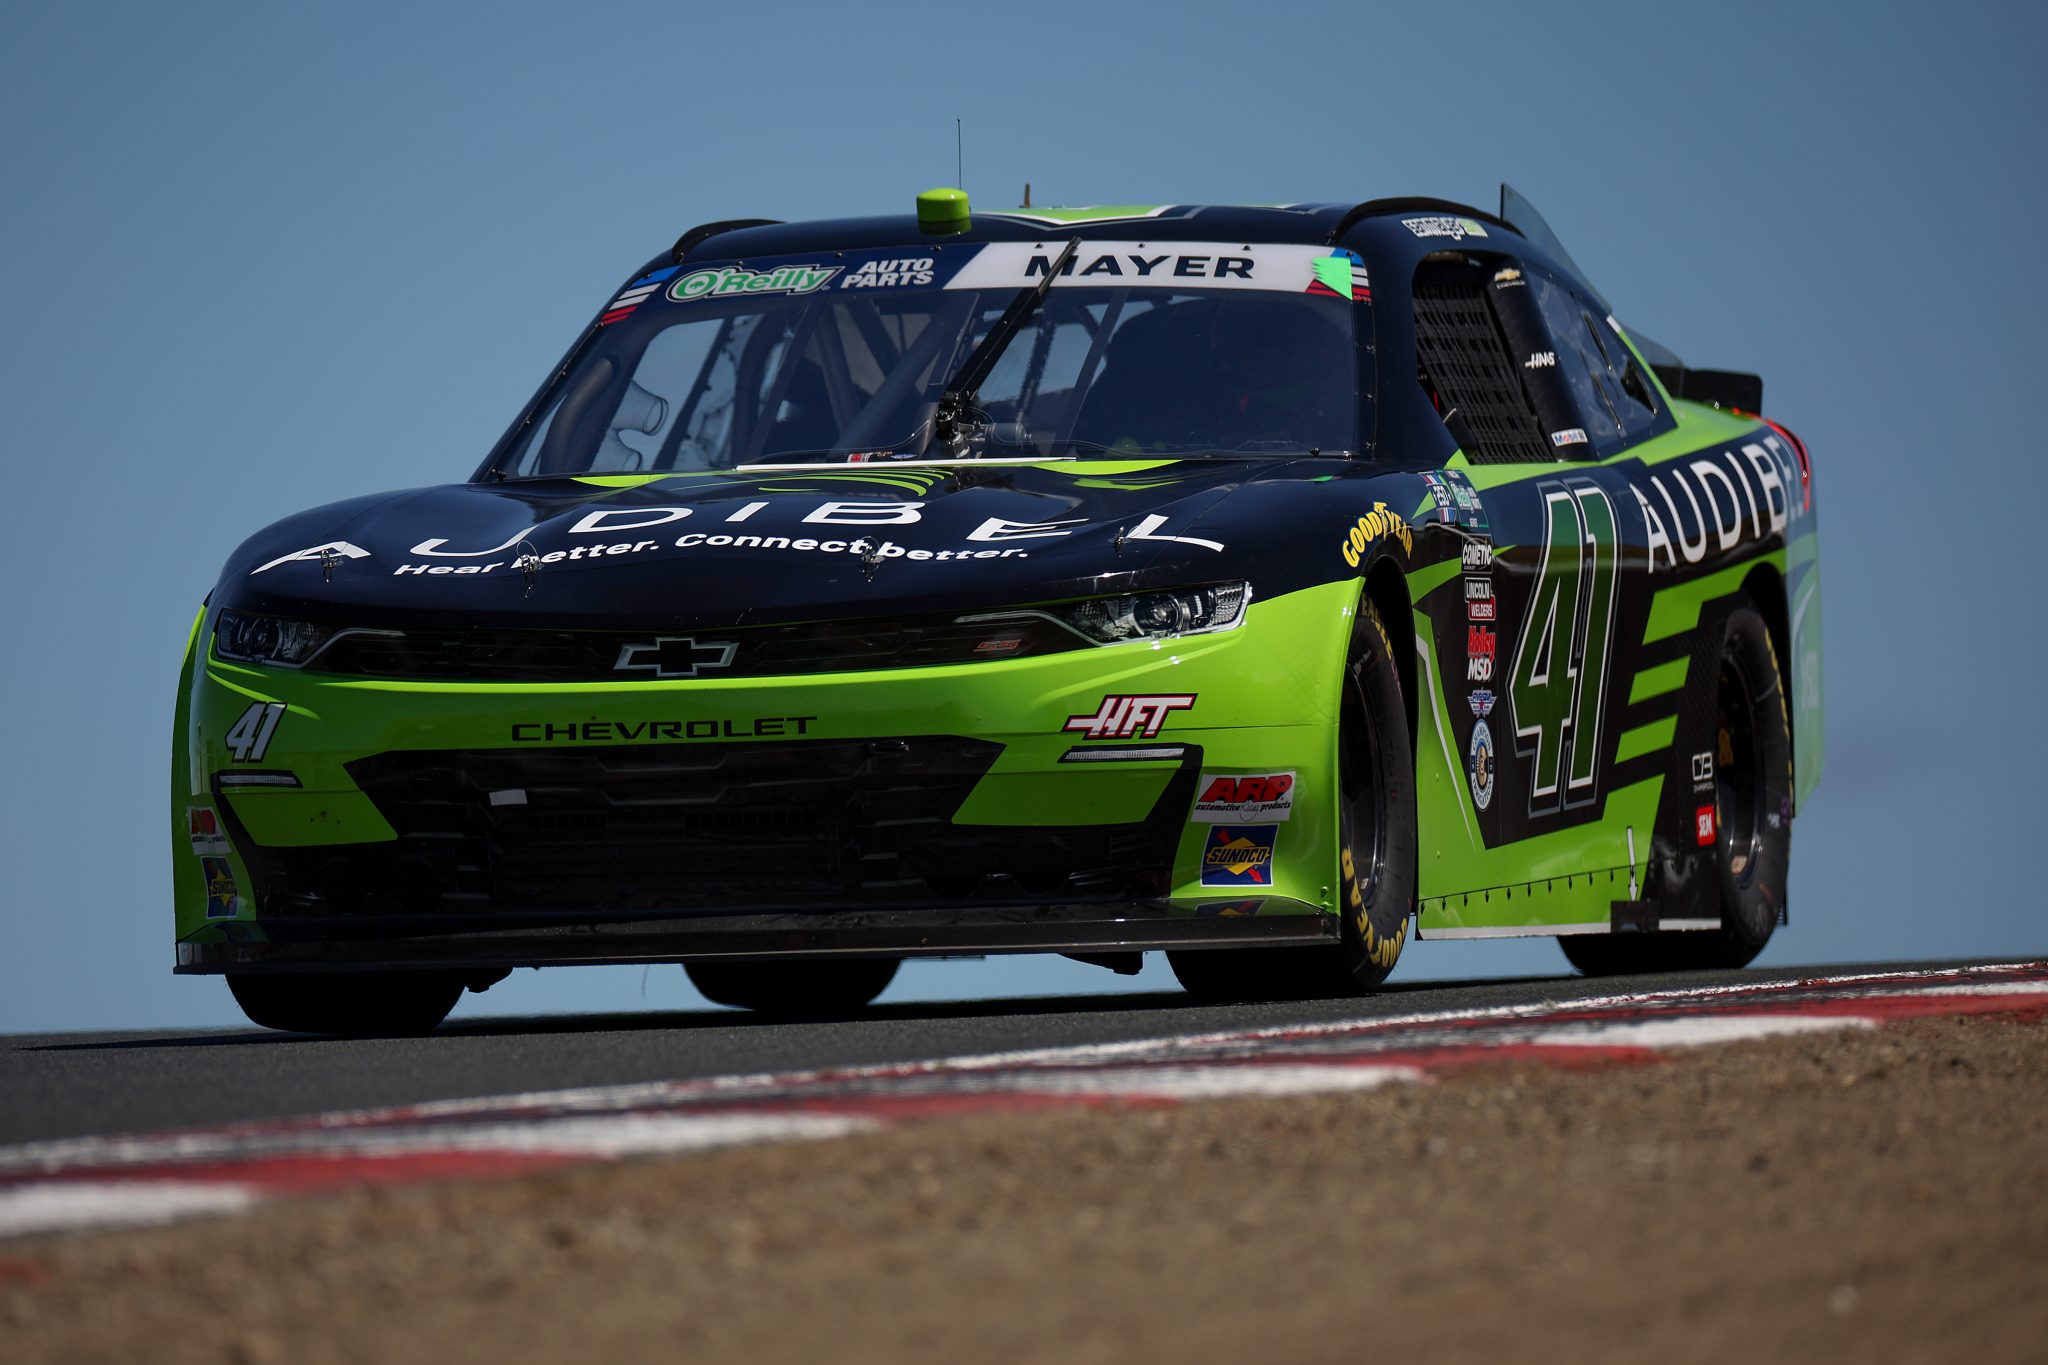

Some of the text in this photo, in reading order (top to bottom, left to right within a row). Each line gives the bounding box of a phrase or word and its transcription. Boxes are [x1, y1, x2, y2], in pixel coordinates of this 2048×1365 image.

[856, 258, 934, 274] AUTO
[1024, 255, 1255, 279] MAYER
[673, 266, 834, 298] O'Reilly
[840, 271, 934, 288] PARTS
[250, 501, 1225, 575] AUDIBEL
[1342, 502, 1413, 567] GOODYEAR
[393, 562, 504, 576] Hear
[675, 533, 869, 555] Connect
[876, 542, 1029, 560] better.
[1463, 544, 1492, 565] COMETIC
[1467, 582, 1490, 599] LINCOLN
[1471, 603, 1492, 617] WELDERS
[1468, 626, 1496, 662] Holley
[1508, 484, 1619, 802] 41
[1467, 658, 1492, 680] MSD
[225, 701, 287, 763] 41
[511, 716, 818, 741] CHEVROLET
[1198, 775, 1292, 803] ARP
[1195, 802, 1241, 812] automotive
[1260, 801, 1291, 812] products
[1208, 848, 1268, 863] SUNOCO
